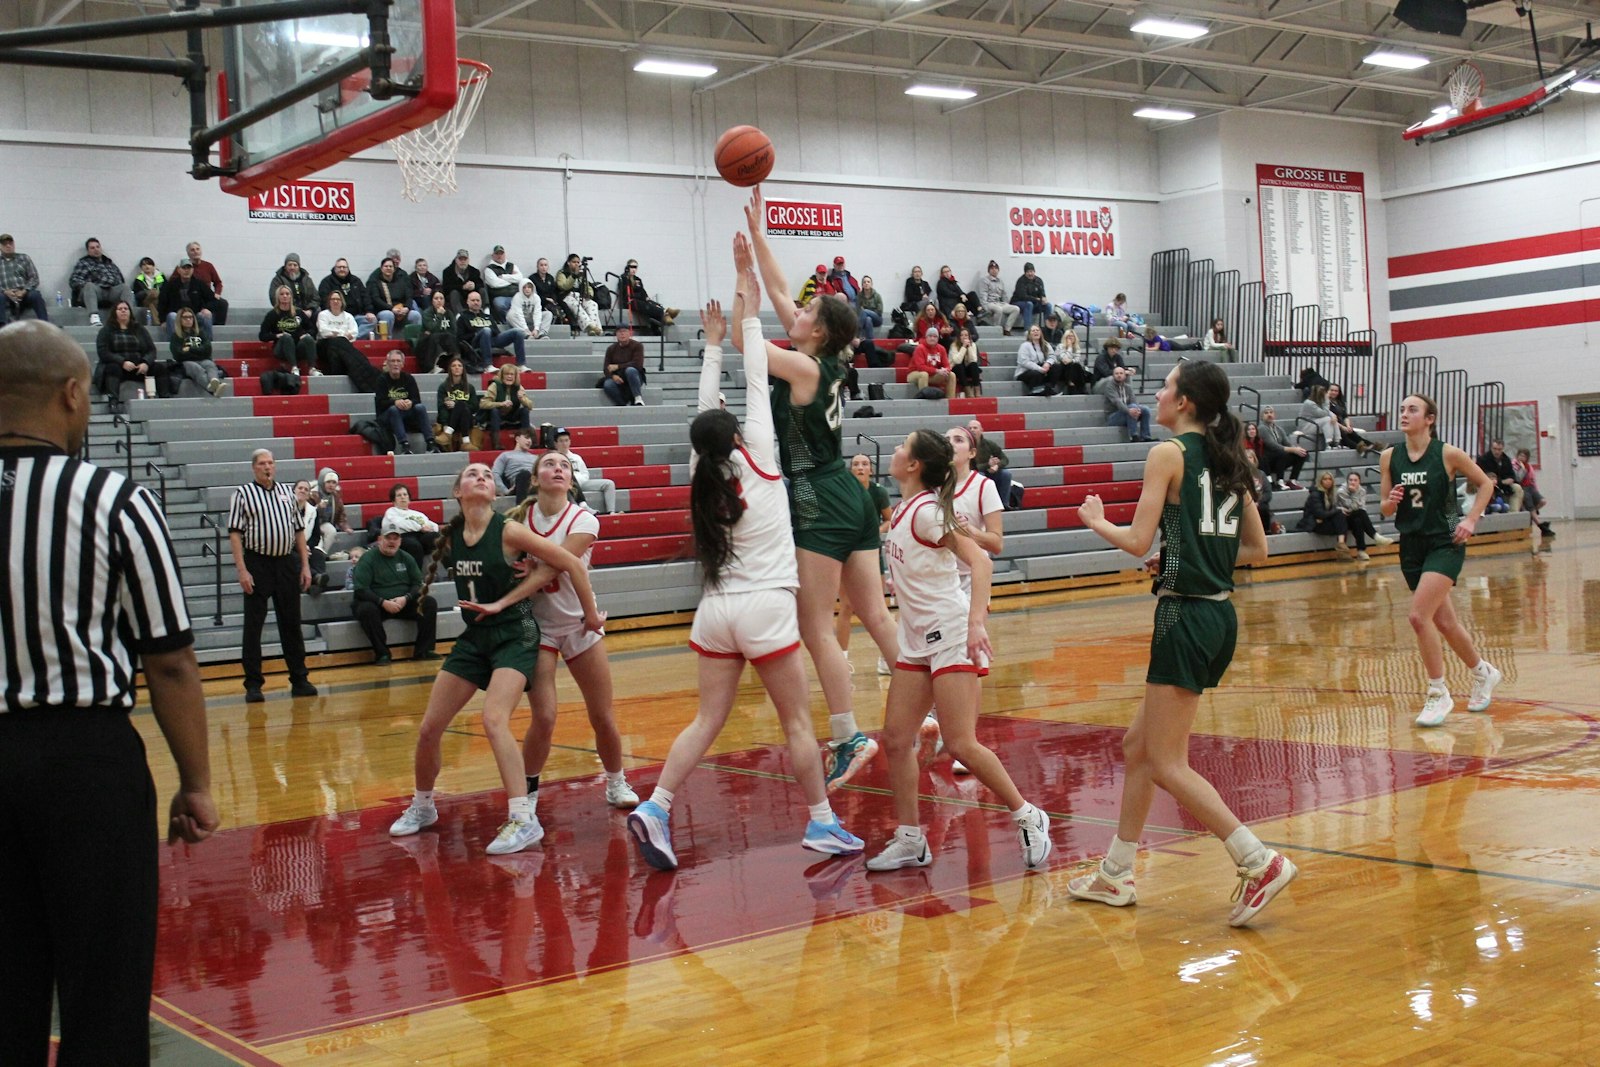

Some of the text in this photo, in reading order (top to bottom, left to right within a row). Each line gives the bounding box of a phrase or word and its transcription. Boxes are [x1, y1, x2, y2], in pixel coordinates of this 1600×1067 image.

[1274, 168, 1347, 183] GROSSE ILE
[259, 184, 351, 210] VISITORS
[767, 205, 841, 227] GROSSE ILE
[1009, 206, 1099, 229] GROSSE ILE
[1010, 229, 1115, 256] RED NATION
[1400, 471, 1428, 486] SMCC
[1198, 468, 1240, 538] 12
[1409, 488, 1425, 508] 2
[456, 560, 483, 577] SMCC
[467, 580, 478, 602] 1
